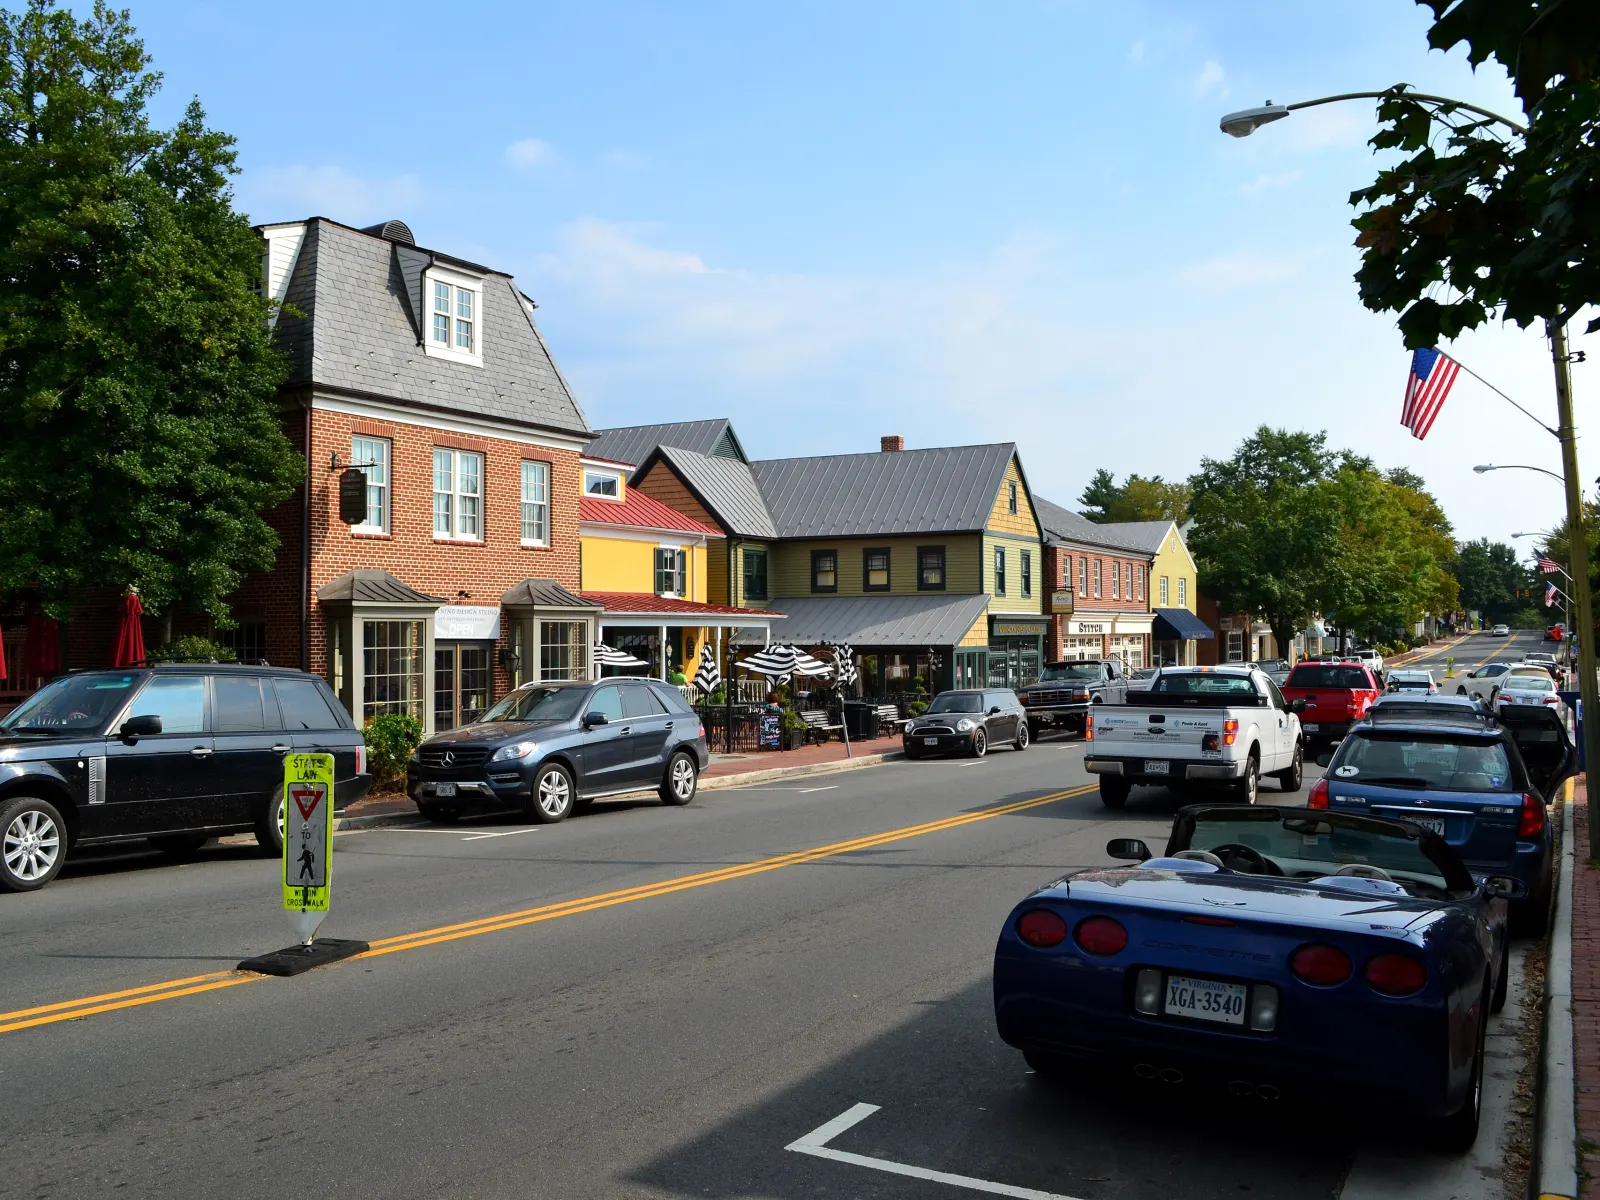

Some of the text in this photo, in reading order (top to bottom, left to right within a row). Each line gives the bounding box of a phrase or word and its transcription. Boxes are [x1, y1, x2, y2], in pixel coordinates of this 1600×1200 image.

[449, 623, 474, 636] OPEN
[293, 758, 323, 768] STATE
[297, 770, 318, 781] LAW
[301, 831, 311, 840] TO
[294, 889, 317, 898] WITIN
[286, 898, 325, 907] CROSWALK
[1142, 939, 1272, 963] CORVETTE
[1187, 980, 1227, 993] VIRGINIA
[1168, 985, 1243, 1016] XGA-3540
